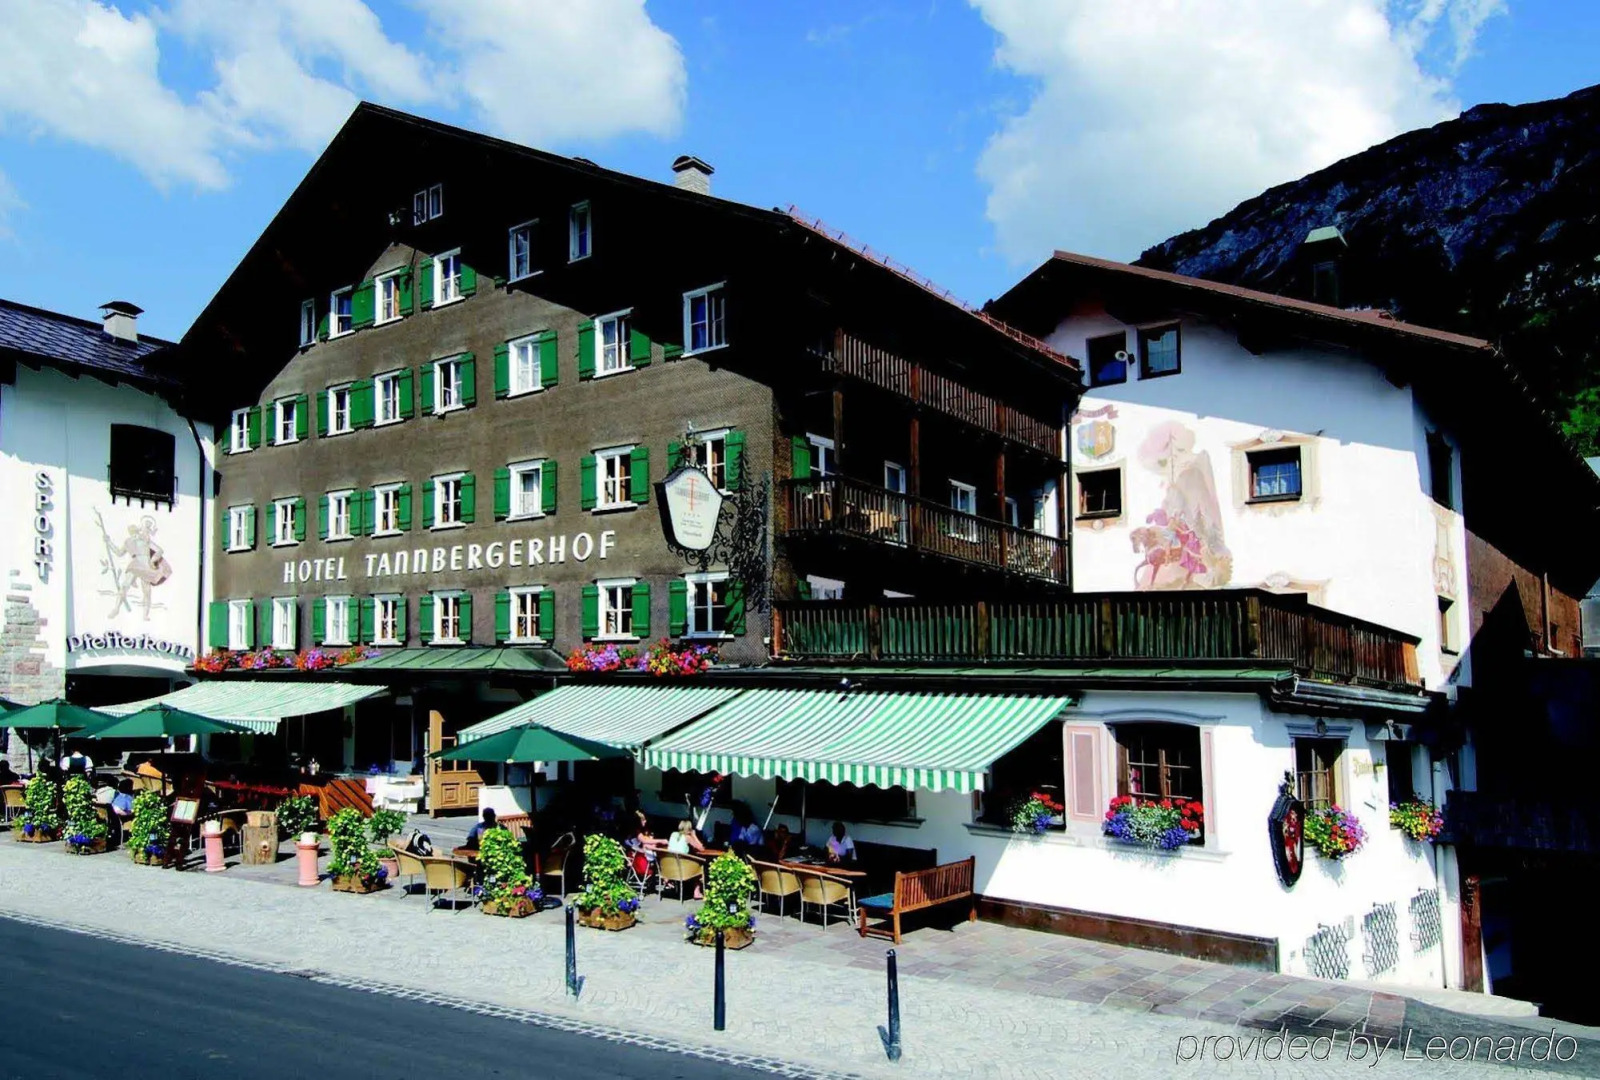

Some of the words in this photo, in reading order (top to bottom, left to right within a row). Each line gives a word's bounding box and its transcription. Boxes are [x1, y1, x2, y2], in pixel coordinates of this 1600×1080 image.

[34, 470, 54, 584] SPORT
[282, 557, 348, 583] HOTEL
[365, 529, 616, 577] TANNBERGERHOF
